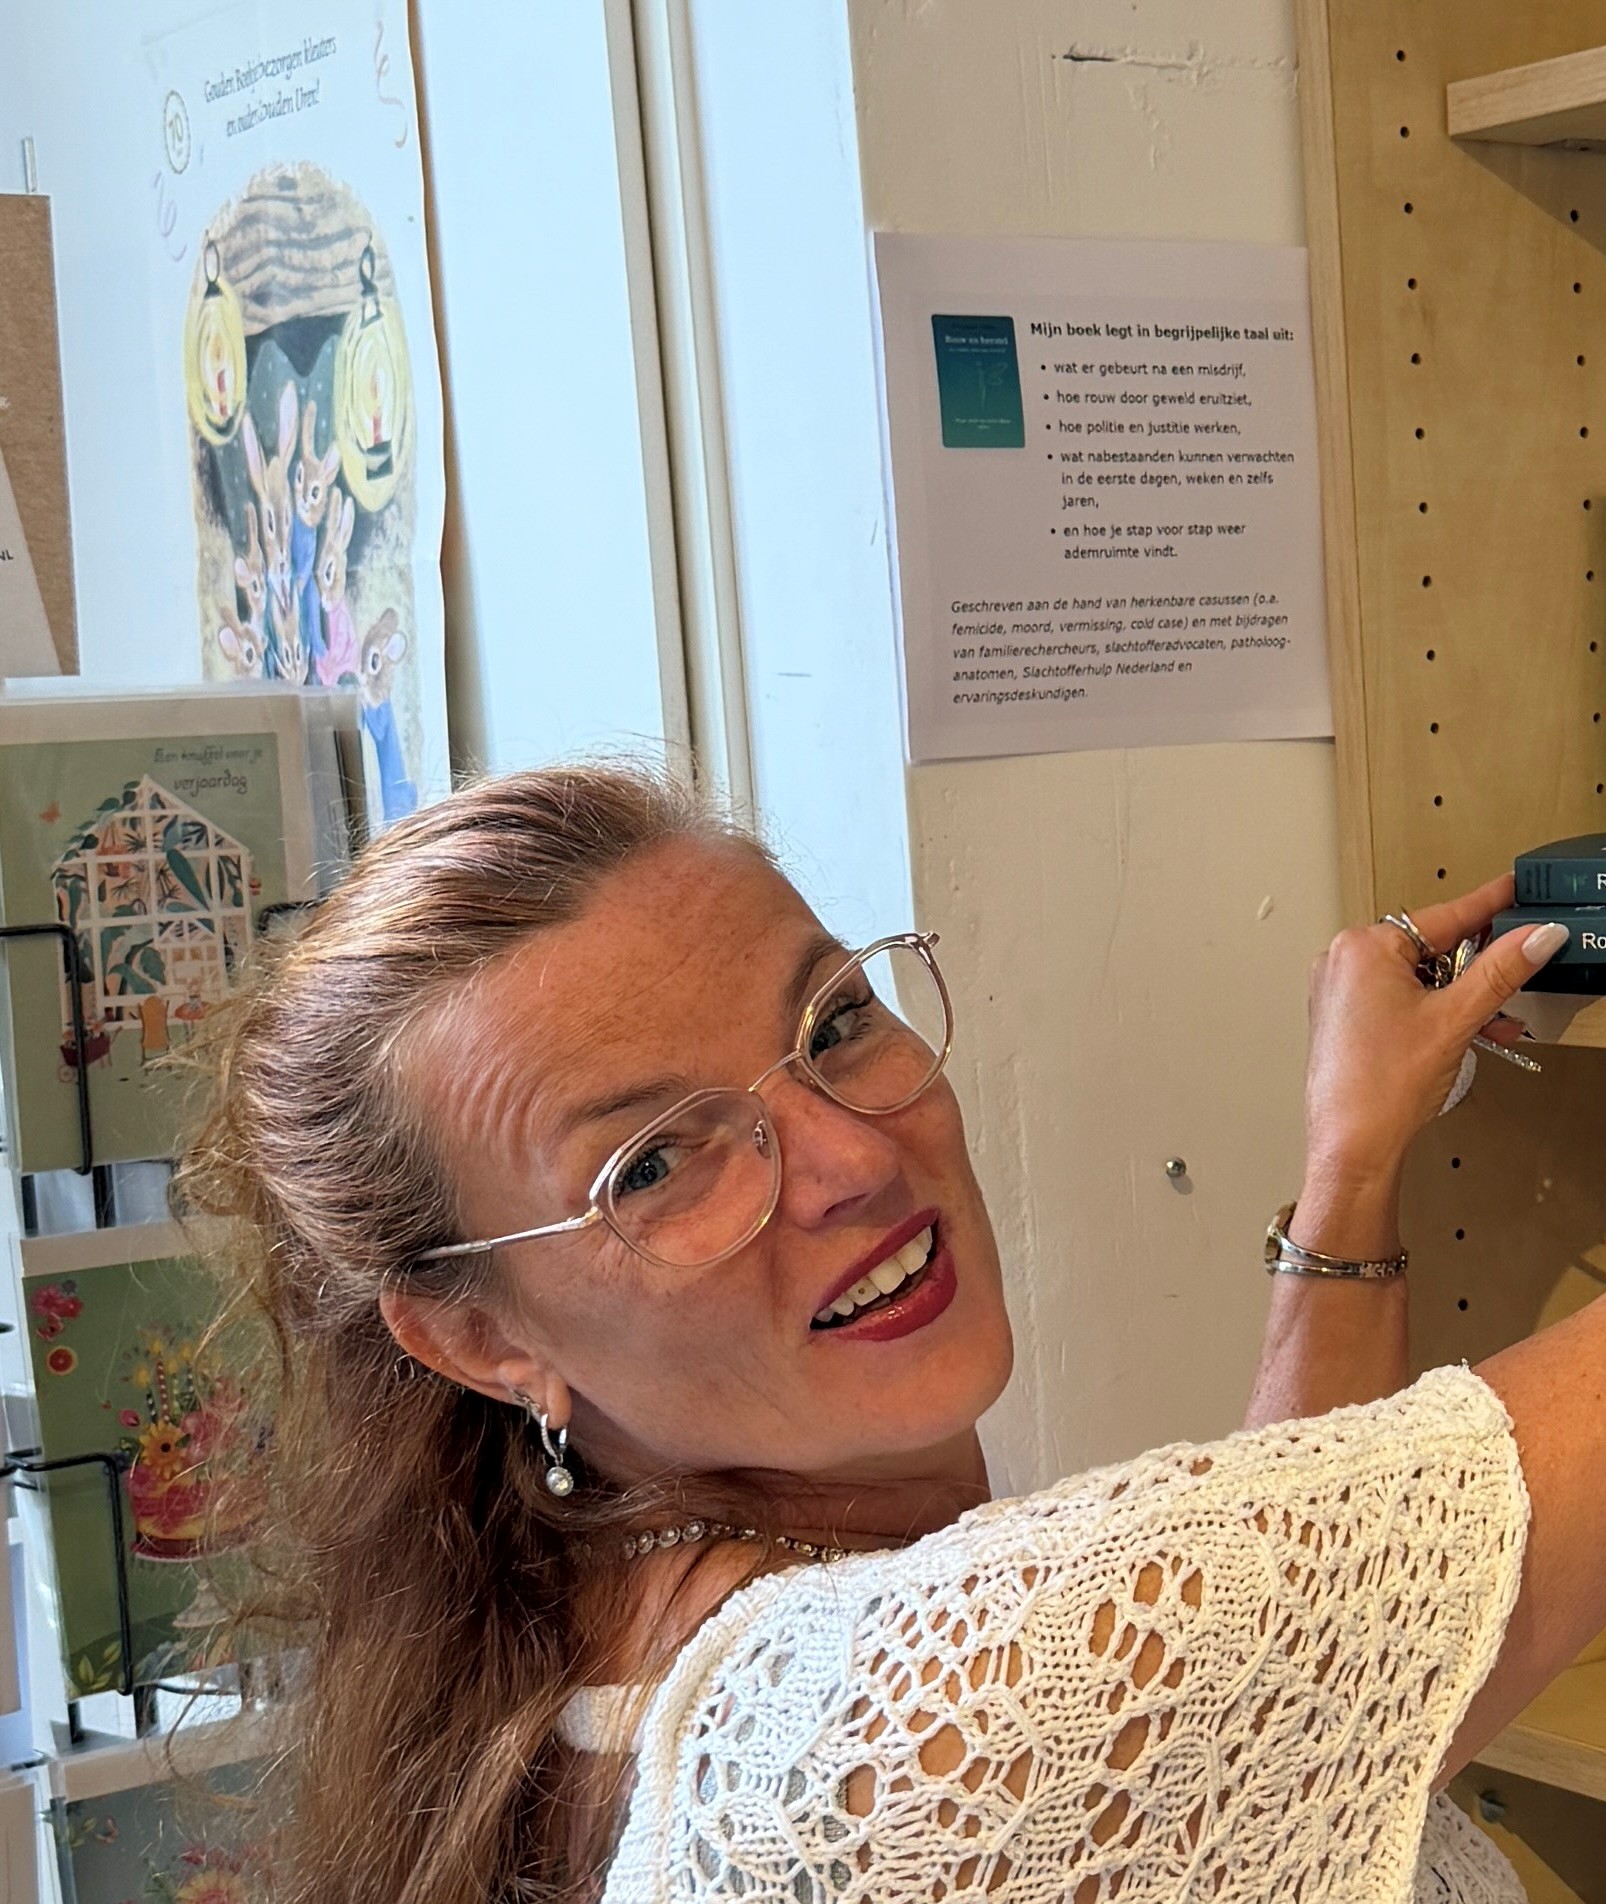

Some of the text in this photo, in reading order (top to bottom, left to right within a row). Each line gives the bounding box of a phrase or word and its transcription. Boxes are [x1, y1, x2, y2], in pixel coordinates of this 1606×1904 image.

[1030, 321, 1294, 342] Mijn boek legt in begrijpelijke taal uit:
[1053, 361, 1246, 380] wat er gebeurt na een misdrijf,
[1056, 389, 1252, 408] hoe rouw door geweld eruitziet,
[1058, 419, 1241, 437] hoe politie en justitie werken,
[1060, 449, 1295, 463] wat nabestaanden kunnen verwachten
[950, 592, 1279, 614] Geschreven aan de hand van herkenbare casussen (o.a.
[951, 614, 1289, 636] femicide, moord, vermissing, cold case) en met bijdragen
[953, 648, 976, 659] van
[952, 659, 1193, 682] anatomen, Slachtofferhulp Nederland en
